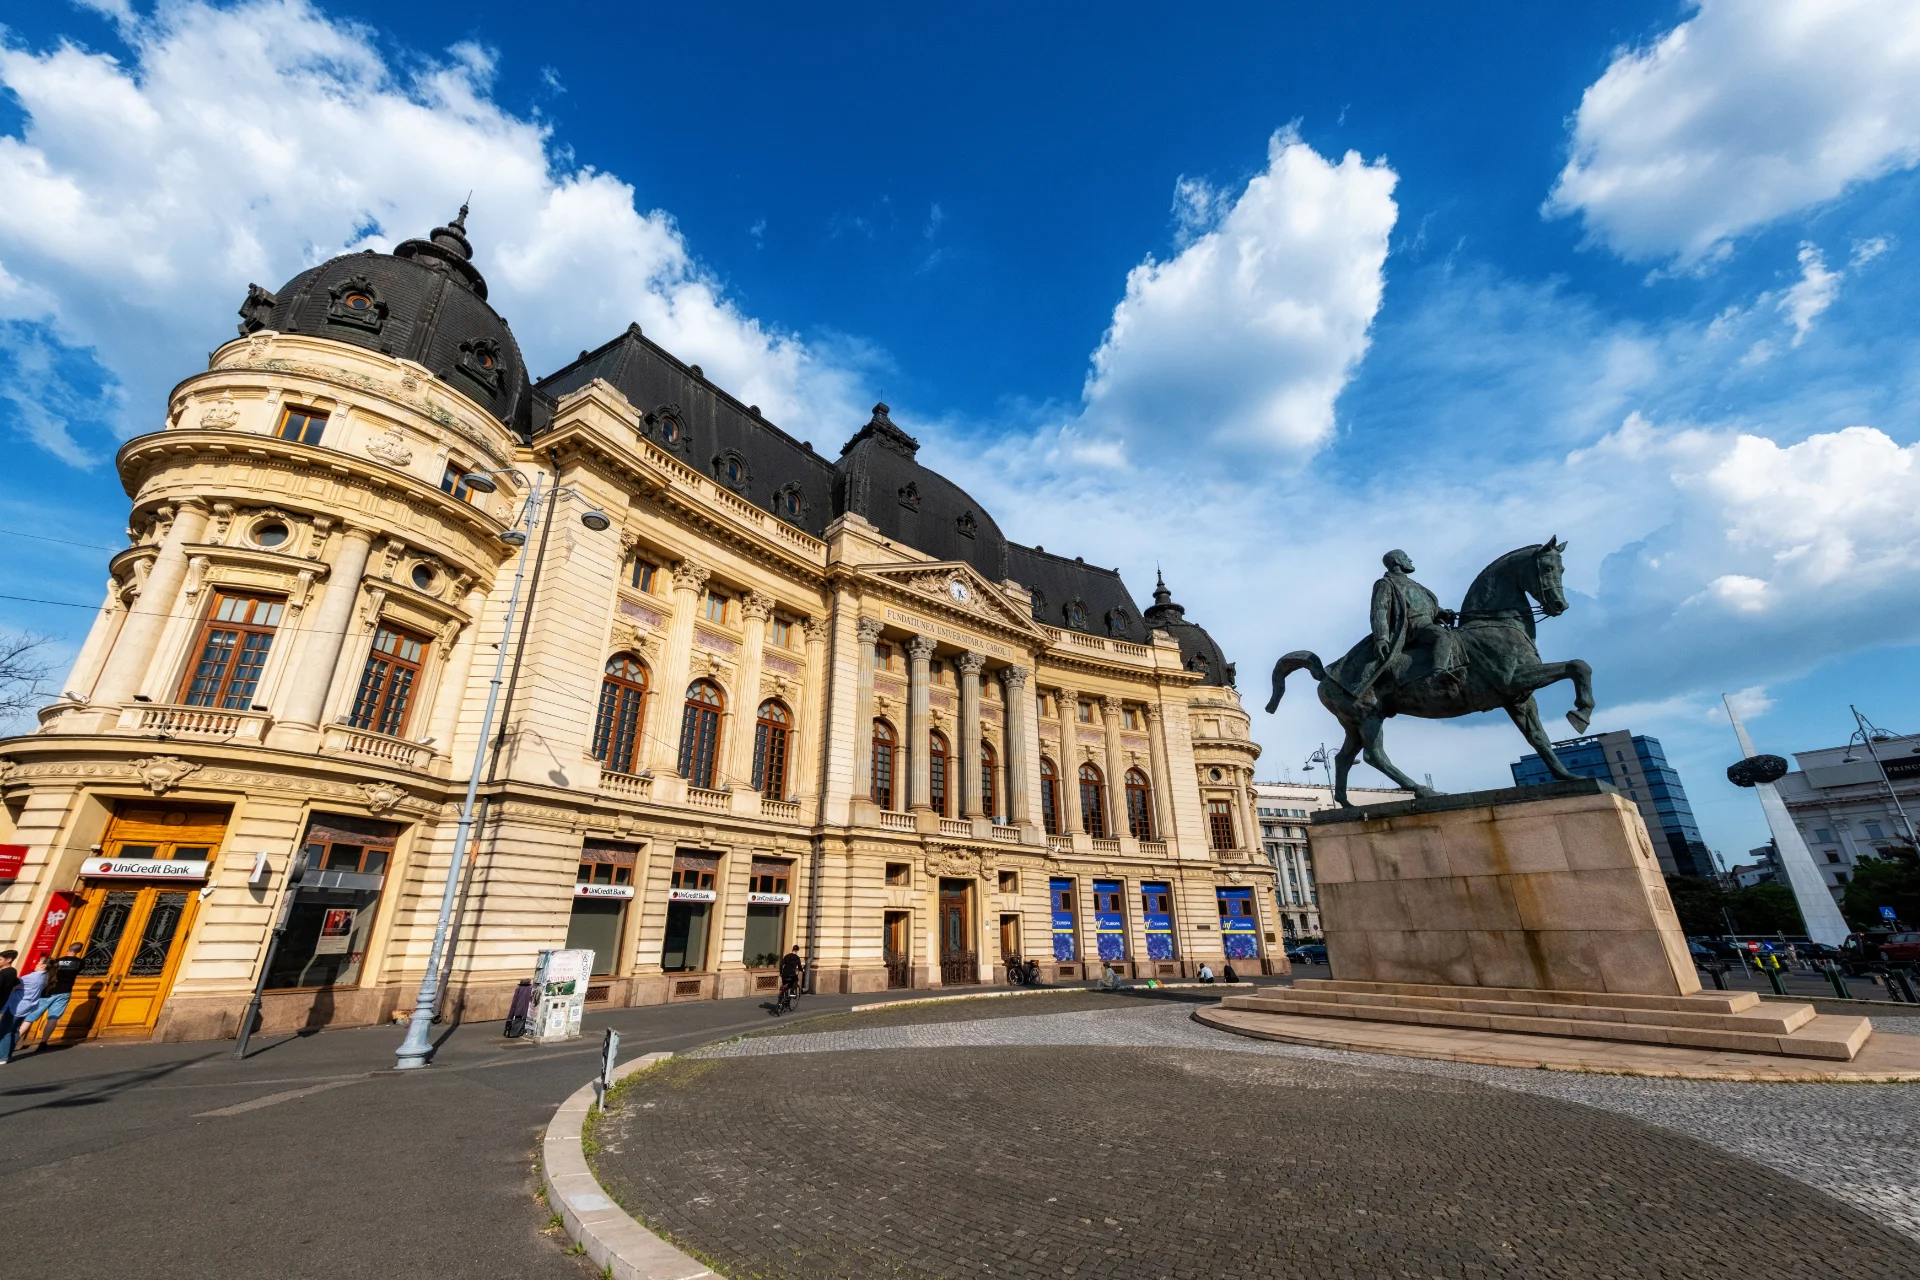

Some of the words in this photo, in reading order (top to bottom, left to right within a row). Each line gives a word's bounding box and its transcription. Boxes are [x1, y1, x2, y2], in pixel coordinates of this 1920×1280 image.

[1886, 763, 1920, 773] PRINC
[113, 863, 162, 874] UniCredit
[163, 864, 190, 874] Bank
[589, 887, 613, 895] UniCredit
[678, 891, 699, 899] UniCredit
